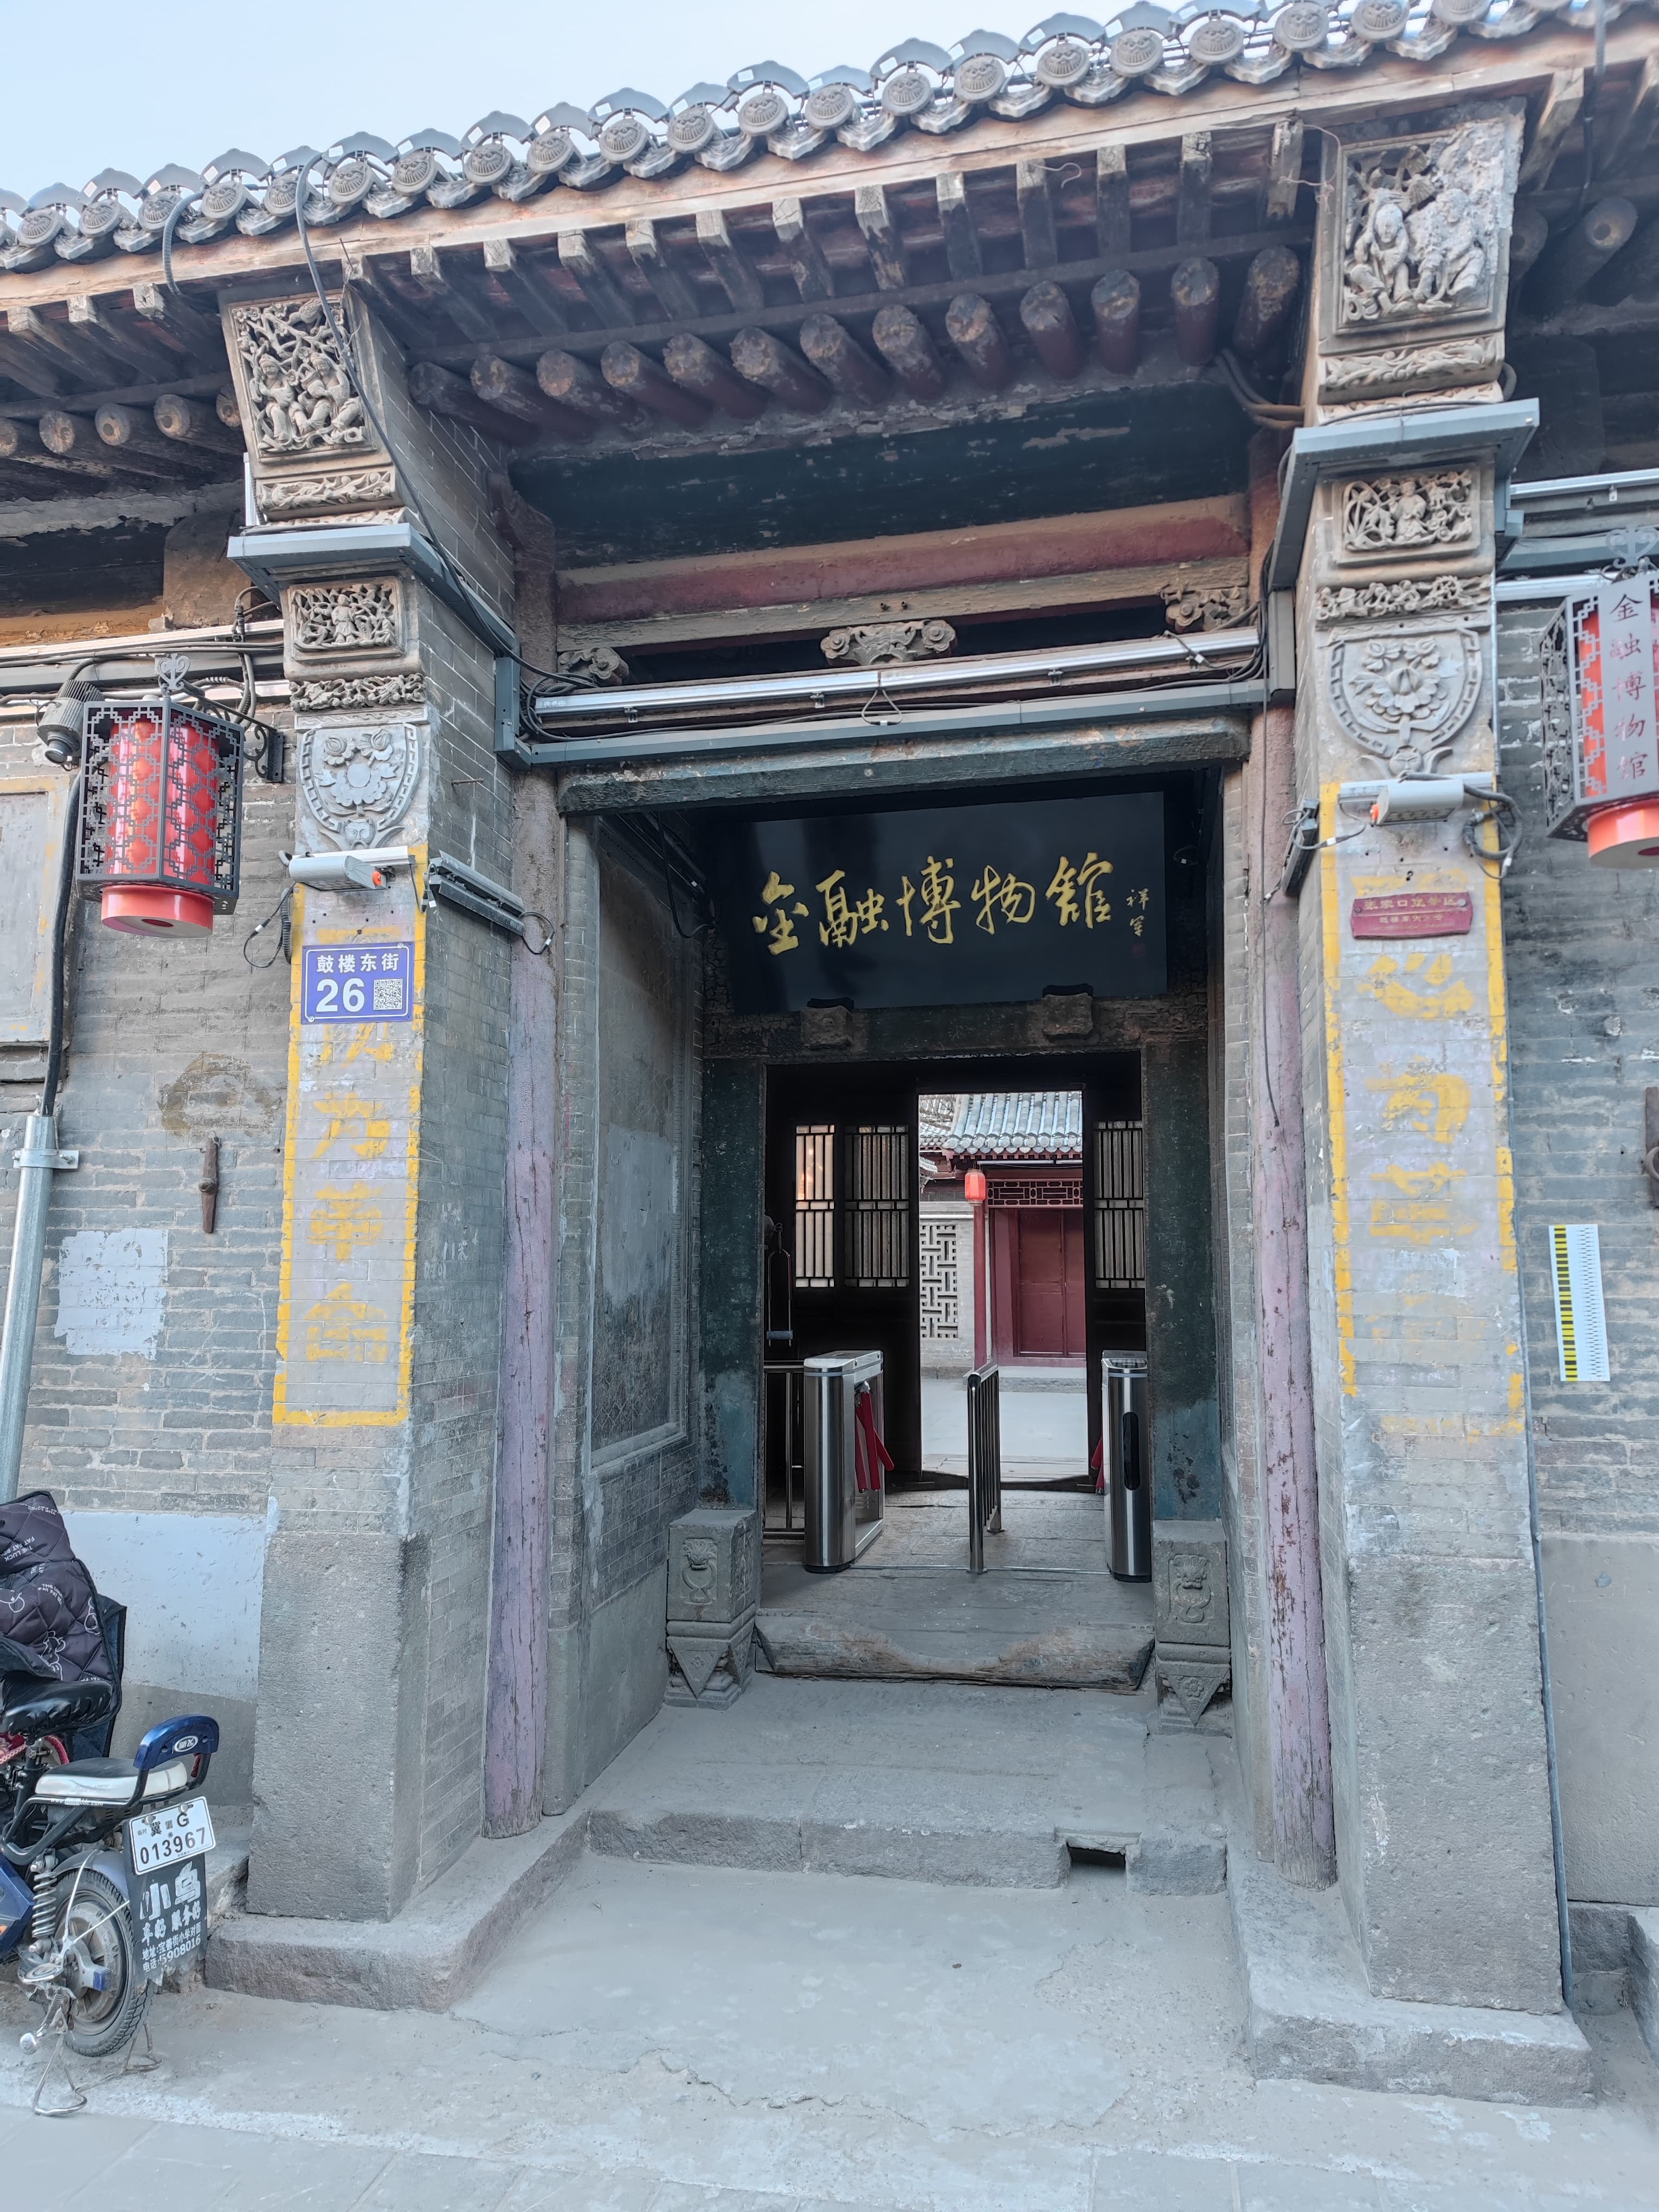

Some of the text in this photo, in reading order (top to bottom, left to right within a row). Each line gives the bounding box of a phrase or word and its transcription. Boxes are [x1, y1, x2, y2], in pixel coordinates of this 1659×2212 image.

[316, 953, 400, 974] 鼓楼东街
[316, 977, 365, 1013] 26
[150, 1821, 162, 1837] 冀
[176, 1812, 189, 1827] G
[140, 1827, 205, 1864] 013967
